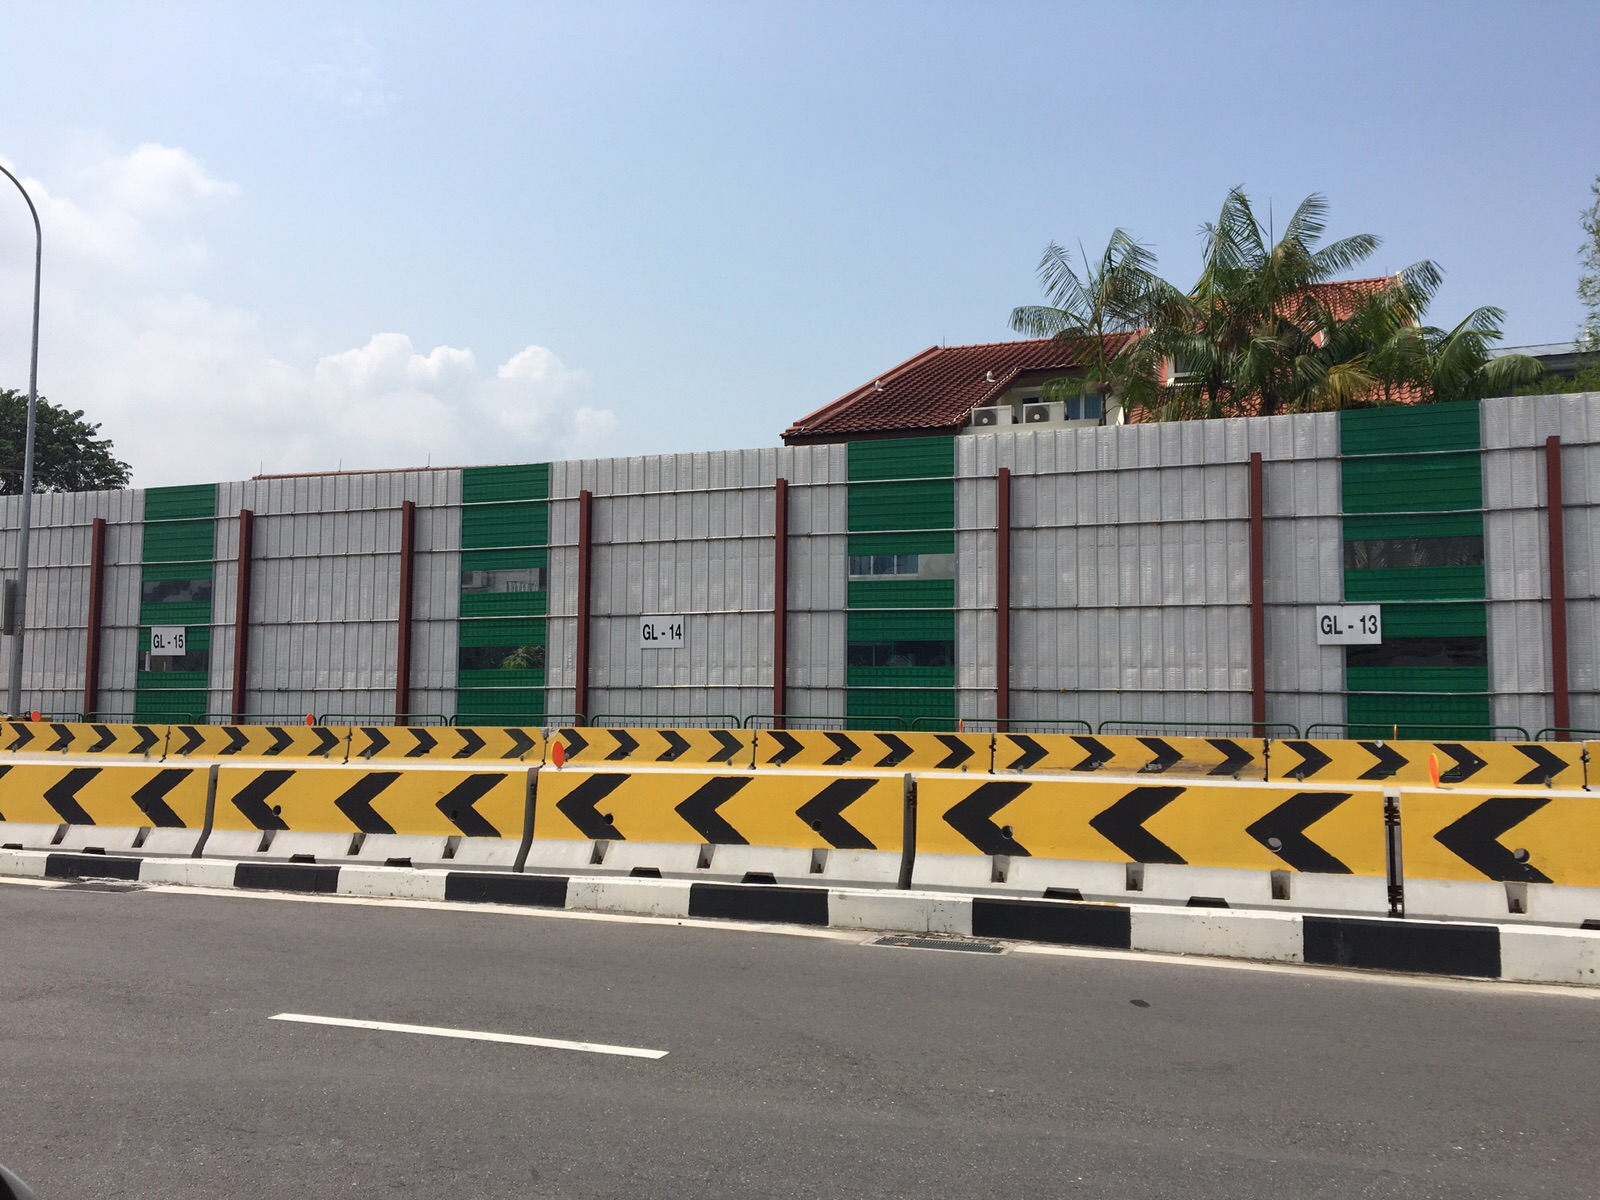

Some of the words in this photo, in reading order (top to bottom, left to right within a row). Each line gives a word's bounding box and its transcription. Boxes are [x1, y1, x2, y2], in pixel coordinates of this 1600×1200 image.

[642, 623, 658, 641] GL
[669, 623, 682, 640] 14
[1321, 615, 1343, 635] GL
[1360, 614, 1378, 635] 13
[153, 634, 165, 649] GL
[173, 634, 184, 649] 15
